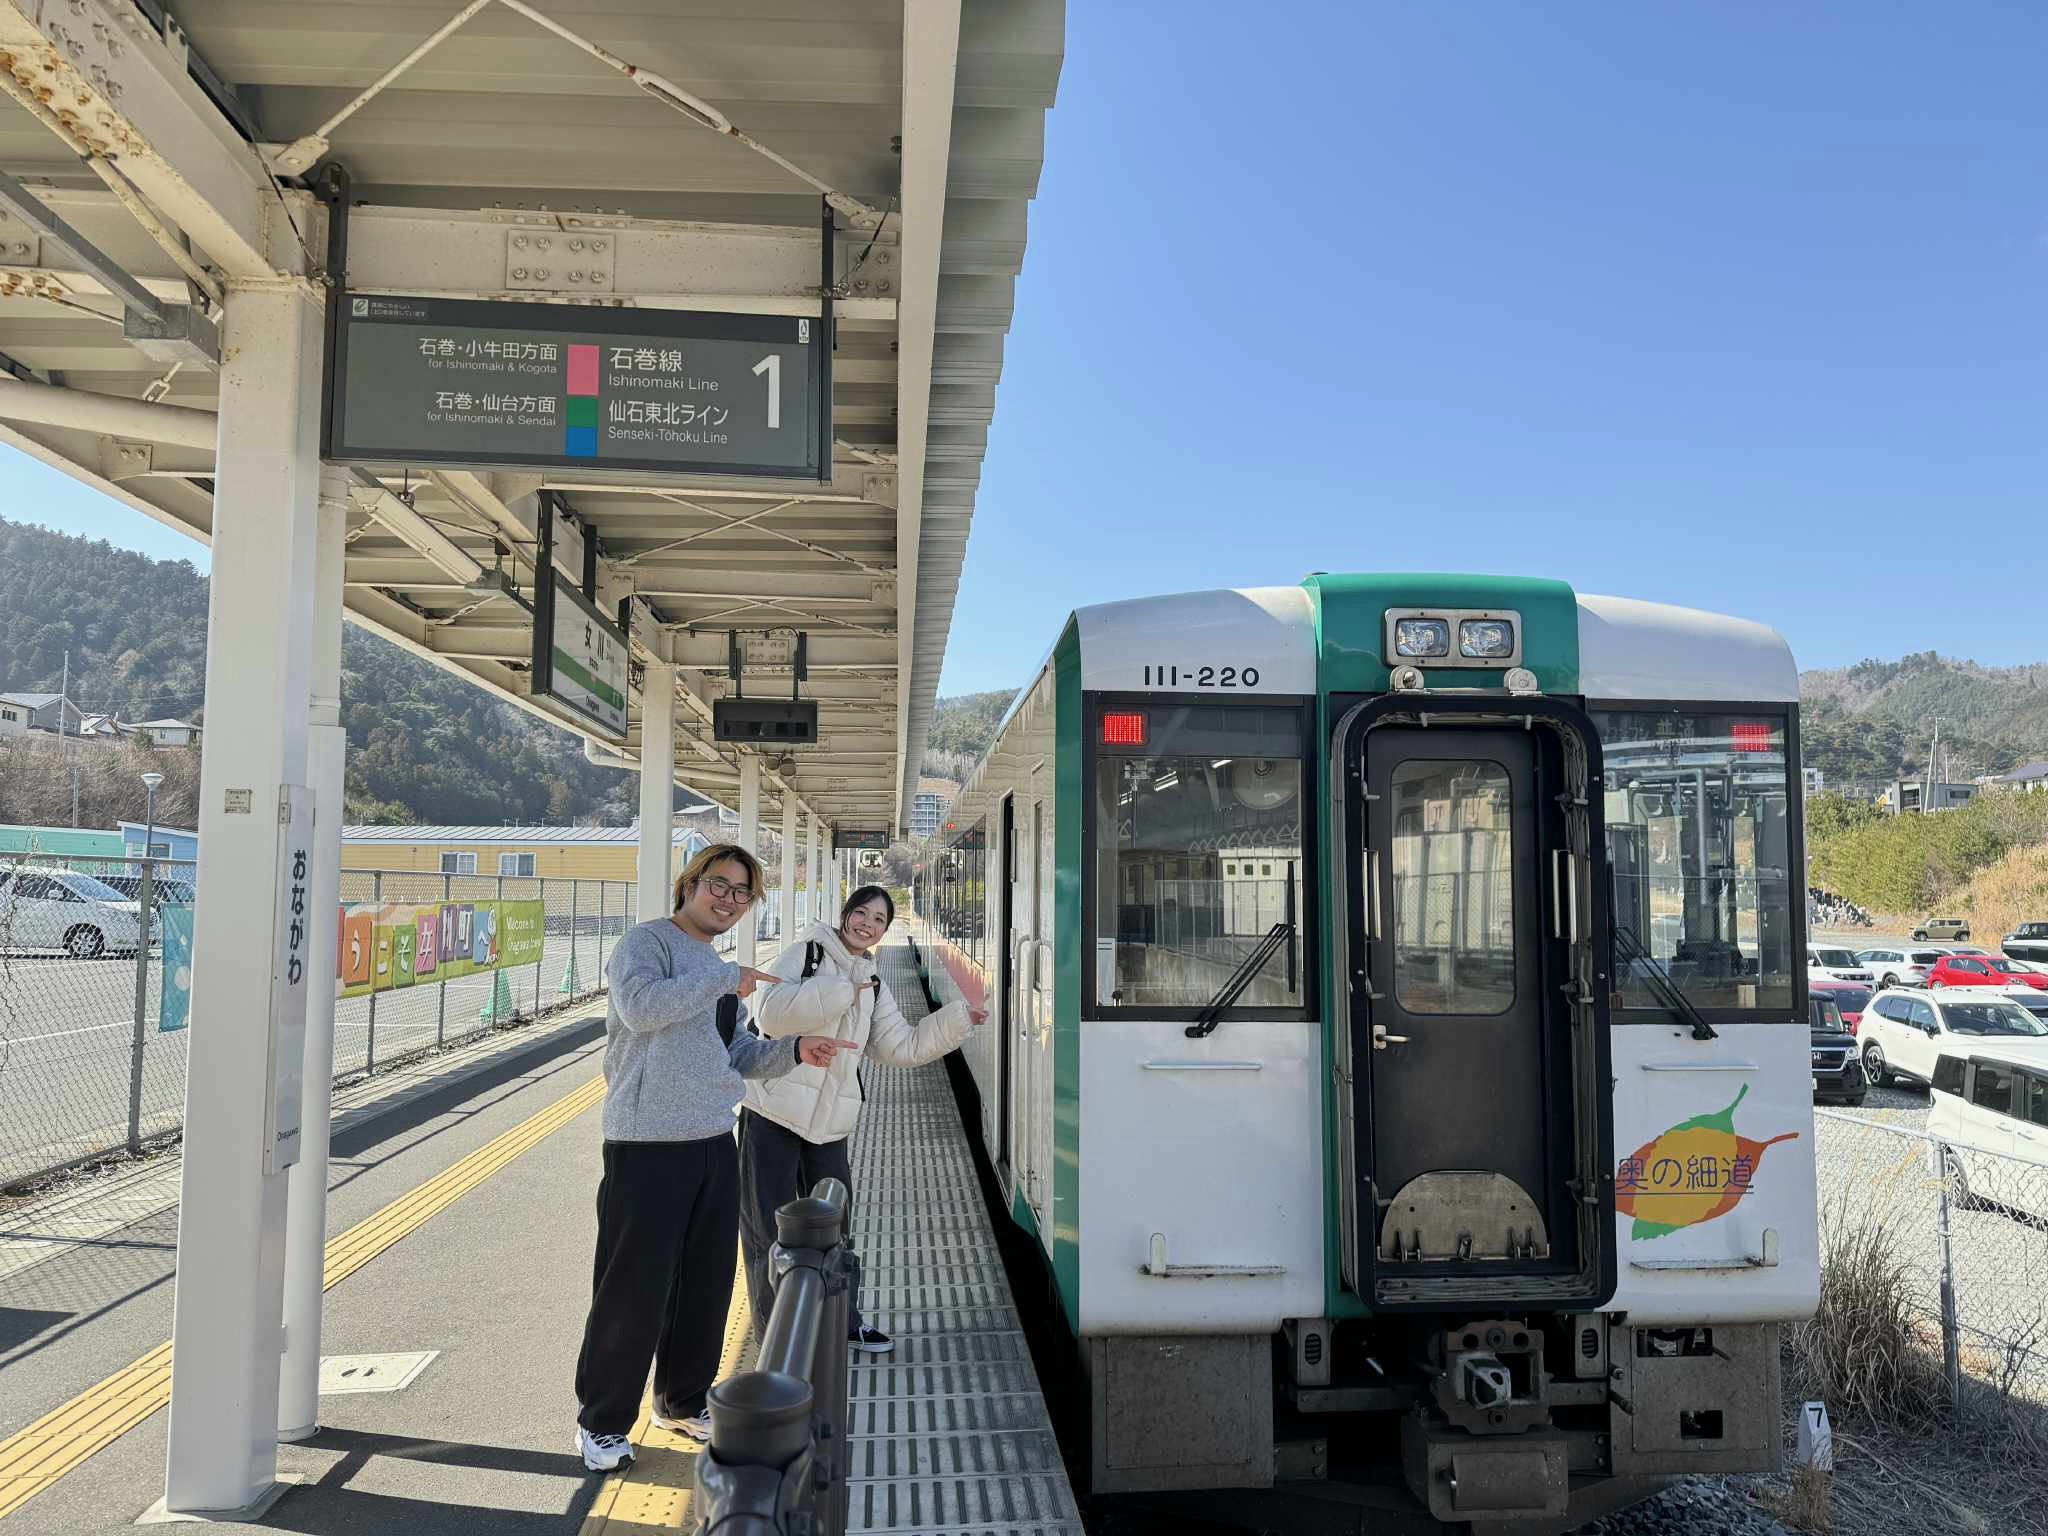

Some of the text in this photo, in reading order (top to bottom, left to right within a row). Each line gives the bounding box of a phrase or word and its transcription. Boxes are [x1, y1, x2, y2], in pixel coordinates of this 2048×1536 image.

[419, 338, 558, 360] 石巻・小牛田方面
[609, 347, 682, 372] 石巻線
[428, 359, 557, 375] for Ishinomaki & Kogota
[608, 374, 719, 391] Ishinomaki Line
[752, 355, 780, 429] 1
[436, 391, 557, 413] 石巻・仙台方面
[608, 400, 729, 426] 仙石東北ライン
[427, 411, 556, 426] for Ishinomaki & Sendai
[703, 433, 728, 444] Line
[288, 850, 306, 985] おながわ
[1616, 1155, 1754, 1190] 奥の細道
[1808, 1407, 1823, 1428] 7
